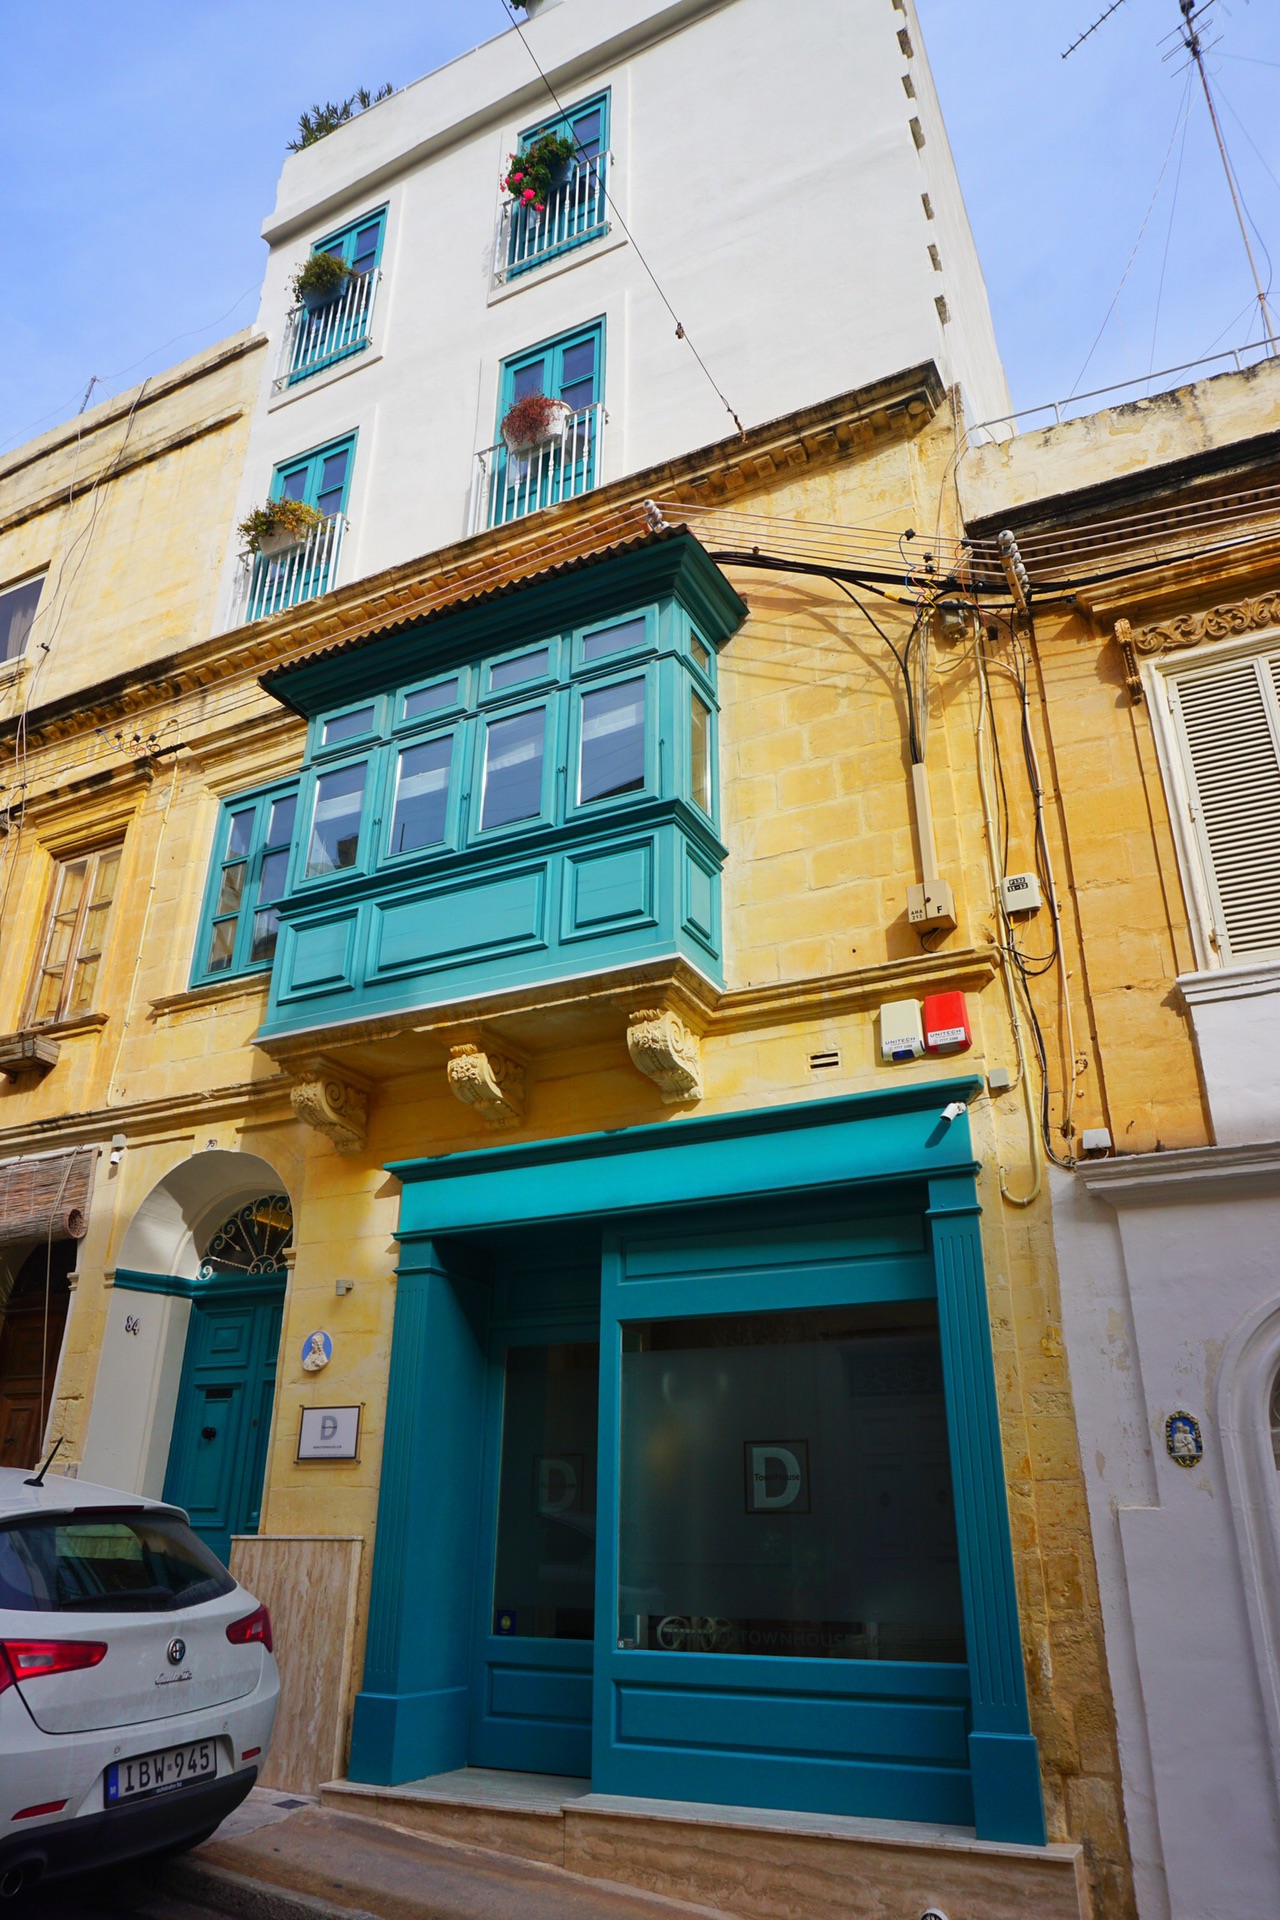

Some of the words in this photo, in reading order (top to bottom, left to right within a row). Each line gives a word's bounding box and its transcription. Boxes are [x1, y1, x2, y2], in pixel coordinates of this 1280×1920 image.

[936, 905, 943, 914] F
[884, 1036, 916, 1045] UNITECH
[929, 1029, 961, 1038] UNITECH
[125, 1314, 140, 1336] 84
[320, 1415, 338, 1441] D
[752, 1446, 801, 1508] D
[753, 1472, 801, 1481] TownHouse
[538, 1459, 577, 1513] D
